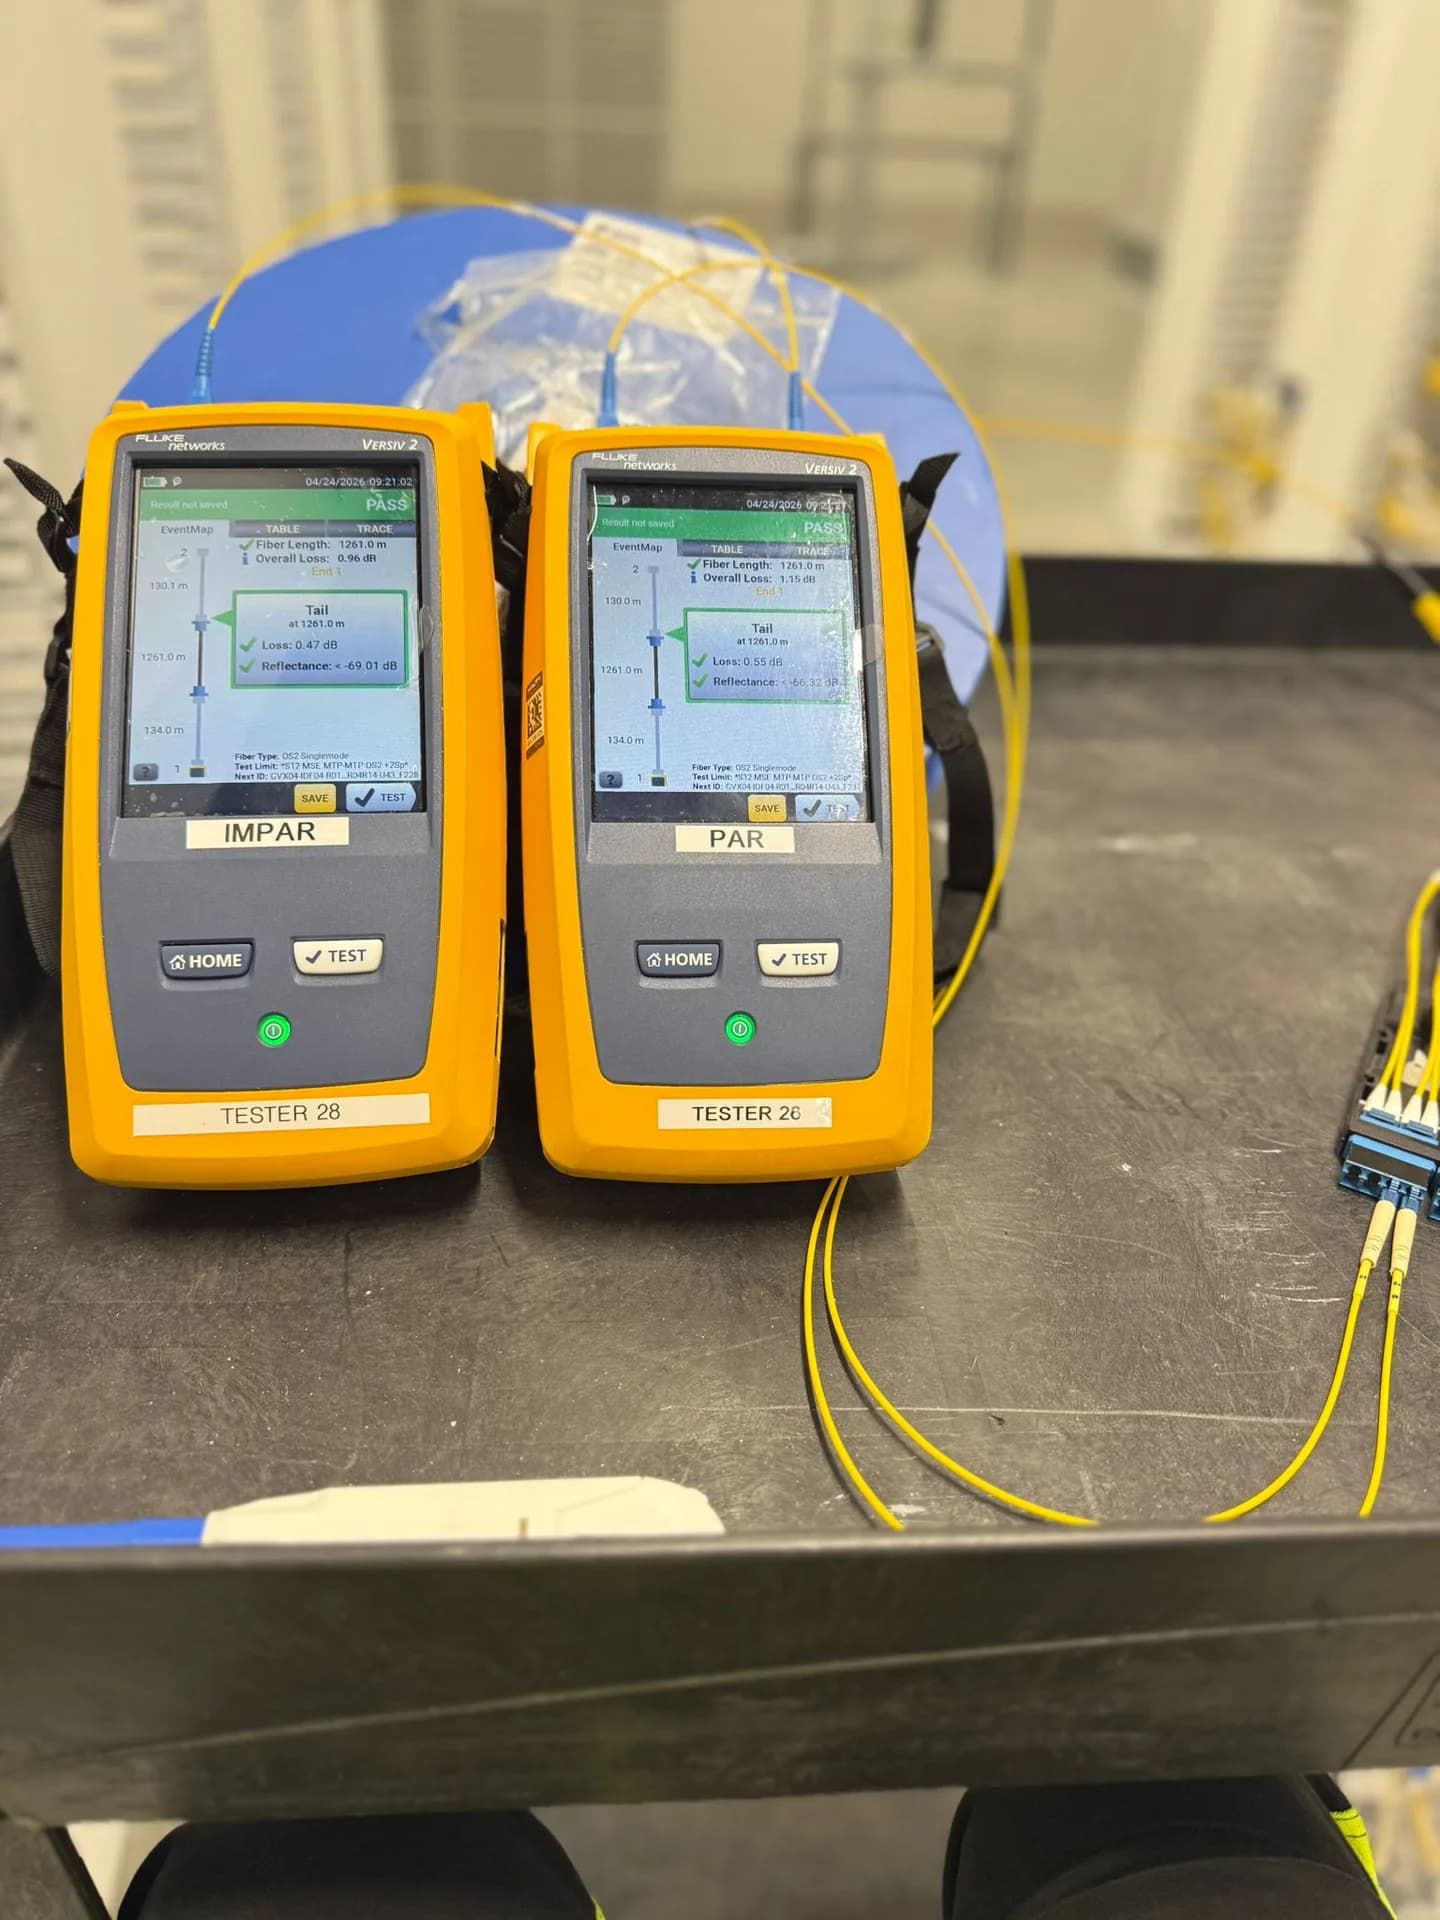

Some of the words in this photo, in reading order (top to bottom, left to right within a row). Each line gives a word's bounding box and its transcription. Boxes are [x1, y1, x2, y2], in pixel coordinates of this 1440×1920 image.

[135, 434, 185, 443] FLUKE
[168, 441, 226, 451] networks
[408, 439, 418, 451] 2
[591, 452, 639, 462] FLUKE
[623, 461, 677, 471] networks
[848, 464, 857, 475] 2
[305, 477, 365, 487] 04/24/2026
[369, 477, 413, 487] 09:21:02
[366, 499, 409, 512] PASS
[746, 499, 802, 510] 04/24/2026
[265, 524, 301, 534] TABLE
[357, 524, 393, 534] TRACE
[602, 519, 629, 528] Result
[632, 519, 645, 528] not
[648, 519, 675, 529] saved
[804, 522, 843, 534] PASS
[161, 525, 214, 536] EventMap
[256, 540, 285, 549] Fiber
[288, 540, 331, 551] Length:
[340, 540, 374, 549] 1261.0
[377, 541, 387, 549] m
[613, 543, 663, 552] EventMap
[711, 544, 744, 554] TABLE
[180, 548, 188, 557] 2
[797, 546, 831, 556] TRACE
[256, 554, 297, 563] Overall
[300, 554, 330, 563] Loss:
[337, 554, 360, 563] 0.96
[363, 554, 377, 563] dB
[633, 565, 640, 574] 2
[703, 560, 730, 569] Fiber
[733, 560, 773, 571] Length:
[780, 561, 813, 570] 1261.0
[815, 563, 825, 571] m
[311, 567, 333, 576] End
[703, 573, 742, 583] Overall
[744, 573, 772, 583] Loss:
[780, 575, 801, 583] 1.15
[803, 575, 816, 584] dB
[150, 582, 175, 590] 130.1
[755, 587, 775, 596] End
[605, 597, 631, 606] 130.0
[632, 598, 642, 606] m
[306, 605, 329, 616] Tail
[289, 620, 299, 628] at
[302, 620, 334, 628] 1261.0
[751, 623, 773, 634] Tail
[262, 640, 292, 650] Loss:
[295, 640, 320, 650] 0.47
[323, 640, 338, 650] dB
[737, 638, 746, 646] at
[748, 638, 778, 646] 1261.0
[141, 653, 174, 661] 1261.0
[712, 657, 741, 667] Loss:
[743, 657, 767, 667] 0.55
[769, 657, 783, 667] dB
[262, 661, 332, 671] Reflectance:
[344, 661, 379, 671] -69.01
[383, 661, 398, 671] dB
[601, 666, 632, 675] 1261.0
[633, 667, 643, 675] m
[713, 677, 778, 687] Reflectance:
[824, 678, 839, 688] dB
[144, 726, 172, 735] 134.0
[174, 727, 184, 735] m
[607, 736, 633, 744] 134.0
[256, 752, 280, 762] Type:
[282, 752, 299, 760] OS2
[301, 751, 350, 761] Singlemode
[234, 762, 253, 770] Test
[255, 762, 279, 770] Limit:
[302, 761, 321, 769] MSE
[366, 761, 382, 769] OS2
[692, 763, 711, 771] Fiber
[712, 763, 733, 772] Type:
[752, 763, 797, 772] Singlemode
[234, 772, 255, 780] Next
[257, 772, 268, 780] ID:
[692, 773, 709, 781] Test
[711, 773, 733, 781] Limit:
[302, 794, 329, 803] SAVE
[380, 793, 406, 802] TEST
[754, 804, 780, 813] SAVE
[225, 821, 316, 843] IMPAR
[710, 829, 764, 849] PAR
[189, 953, 242, 969] HOME
[328, 949, 367, 963] TEST
[664, 953, 713, 967] HOME
[792, 952, 828, 966] TEST
[220, 1104, 308, 1125] TESTER
[316, 1102, 341, 1121] 28
[692, 1105, 773, 1122] TESTER
[779, 1105, 802, 1121] 26
